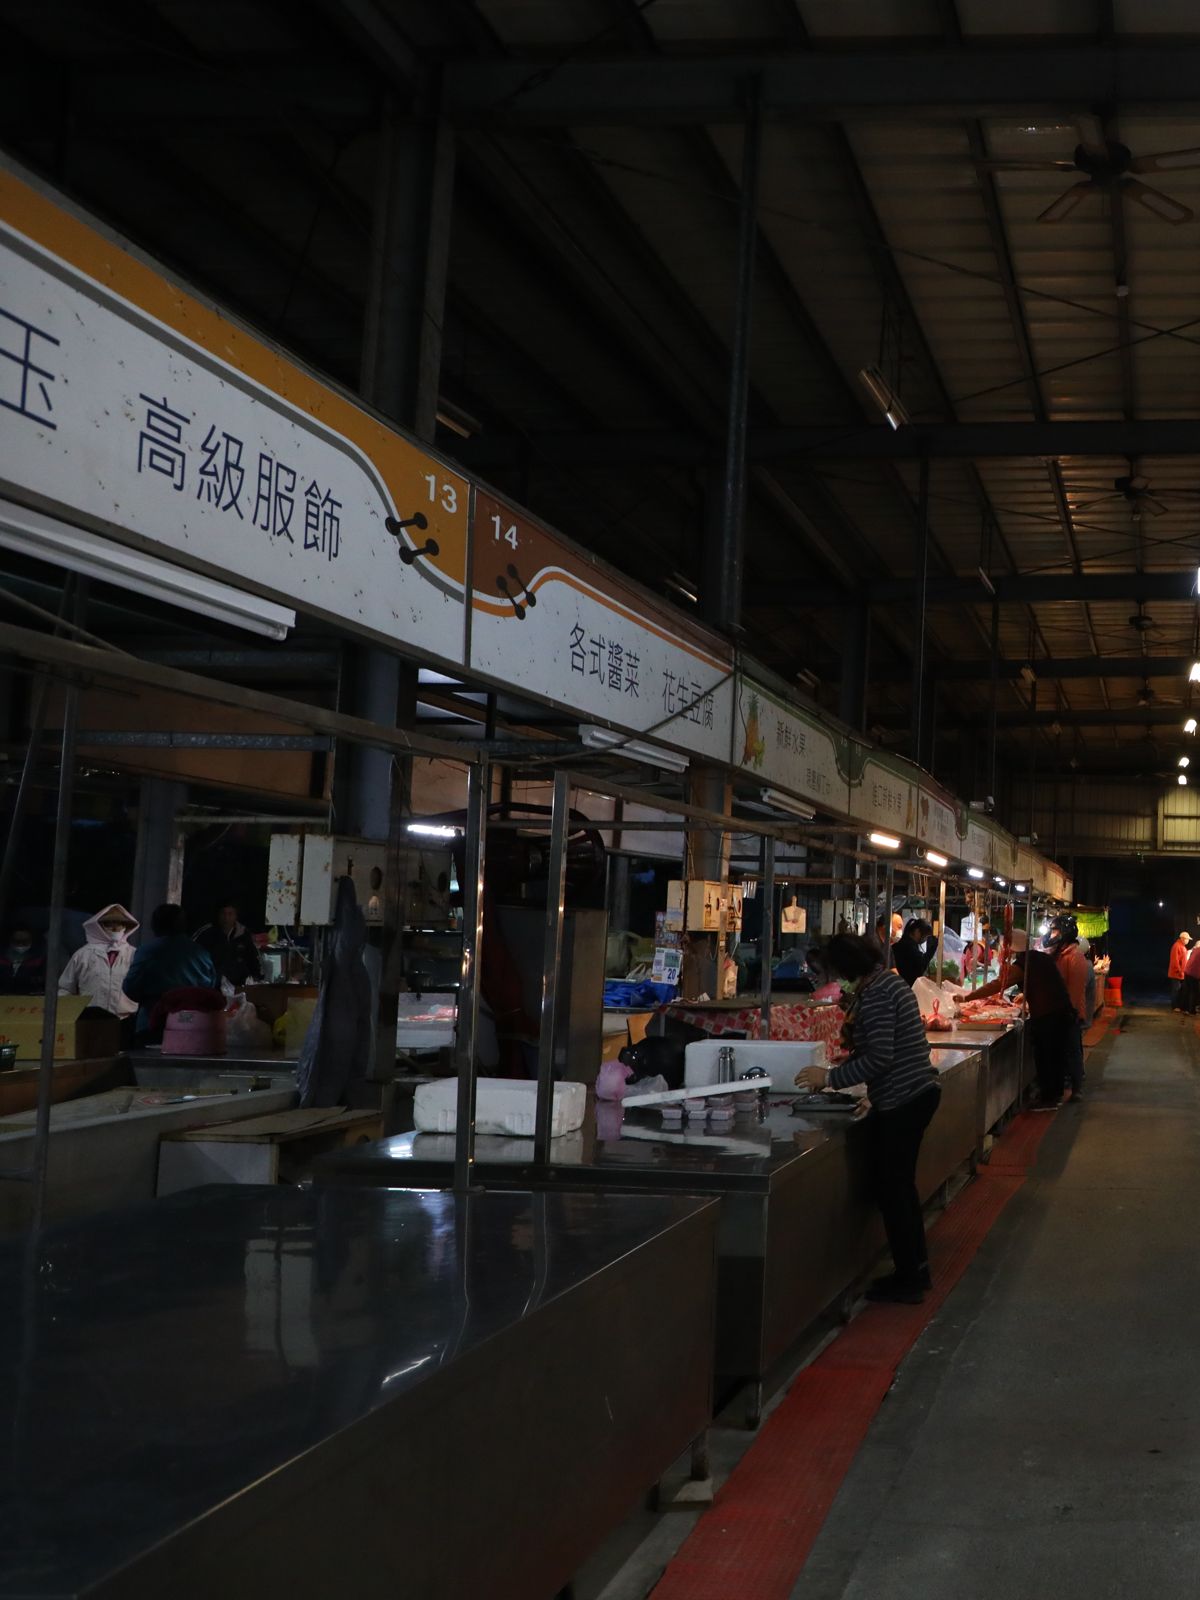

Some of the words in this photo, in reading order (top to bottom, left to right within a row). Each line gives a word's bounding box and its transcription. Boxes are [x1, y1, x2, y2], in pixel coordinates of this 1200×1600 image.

[138, 393, 343, 562] 高級服飾
[424, 474, 458, 514] 13
[491, 515, 519, 550] 14
[569, 622, 640, 698] 各式醬菜
[662, 668, 714, 731] 花生豆腐
